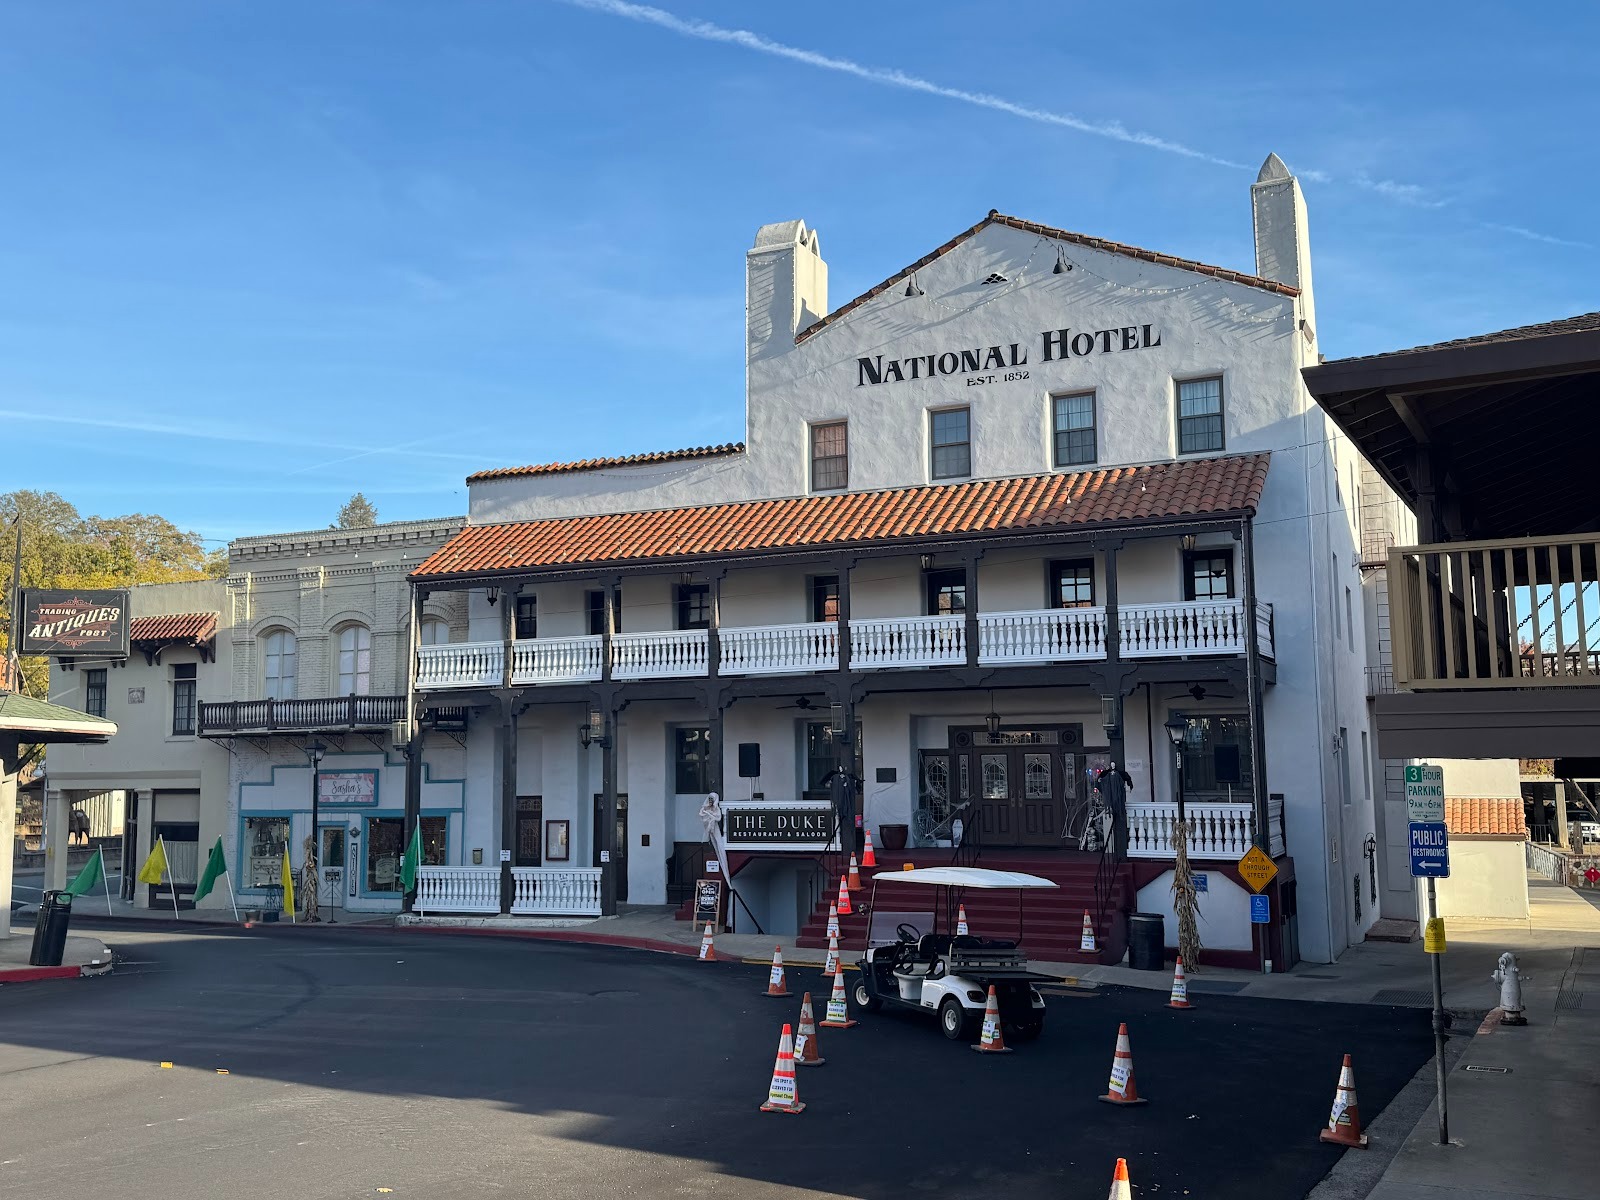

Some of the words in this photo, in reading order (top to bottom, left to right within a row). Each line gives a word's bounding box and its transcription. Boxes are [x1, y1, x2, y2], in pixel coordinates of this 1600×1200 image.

[857, 342, 1028, 387] NATIONAL
[1041, 323, 1161, 362] HOTEL
[966, 375, 998, 386] EST.
[1004, 370, 1030, 382] 1852
[28, 607, 120, 638] ANTIQUES
[79, 629, 107, 637] POST
[1410, 767, 1418, 781] 3
[1422, 771, 1441, 781] HOUR
[331, 780, 362, 795] Sasha's
[1408, 785, 1442, 797] PARKING
[733, 816, 766, 829] THE
[777, 816, 826, 829] DUKE
[1412, 830, 1444, 846] PUBLIC
[1412, 848, 1446, 857] RESTROOMS
